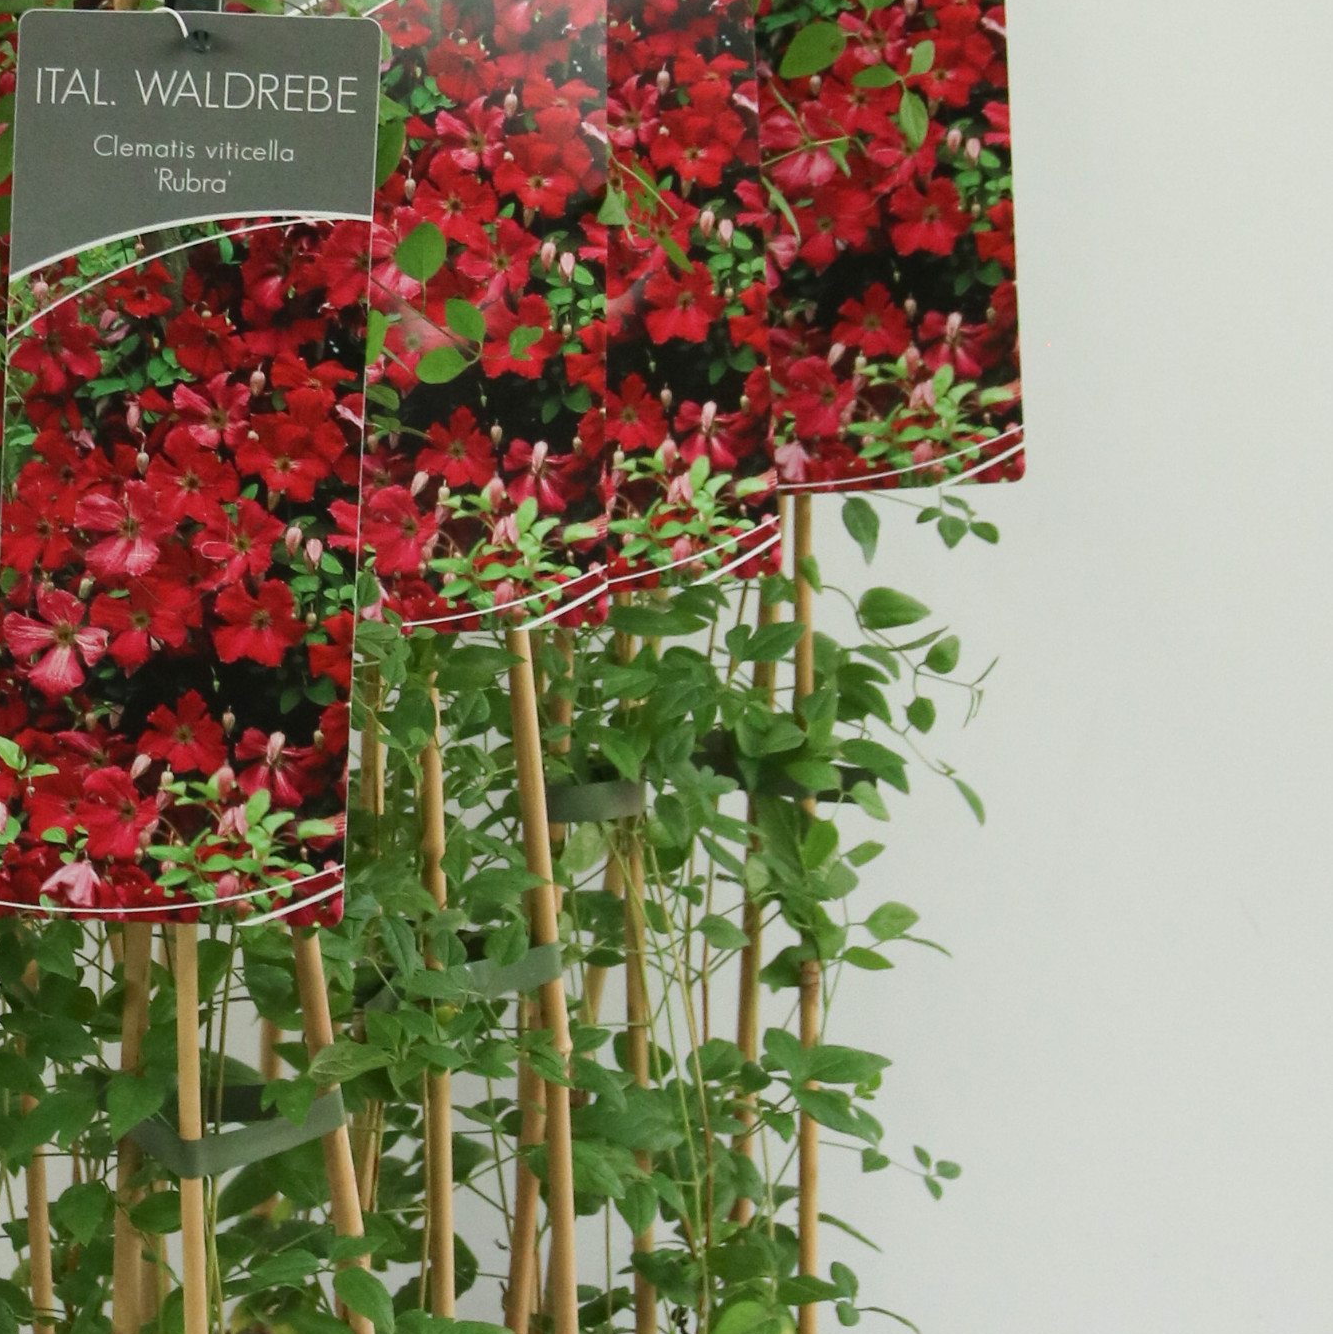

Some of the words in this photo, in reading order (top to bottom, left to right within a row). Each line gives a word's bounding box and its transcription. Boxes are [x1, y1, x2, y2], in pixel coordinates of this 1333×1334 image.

[36, 67, 116, 106] ITAL.
[135, 69, 358, 114] WALDREBE
[93, 134, 195, 159] Clematis
[205, 139, 294, 162] viticella
[154, 168, 232, 194] 'Rubra'
